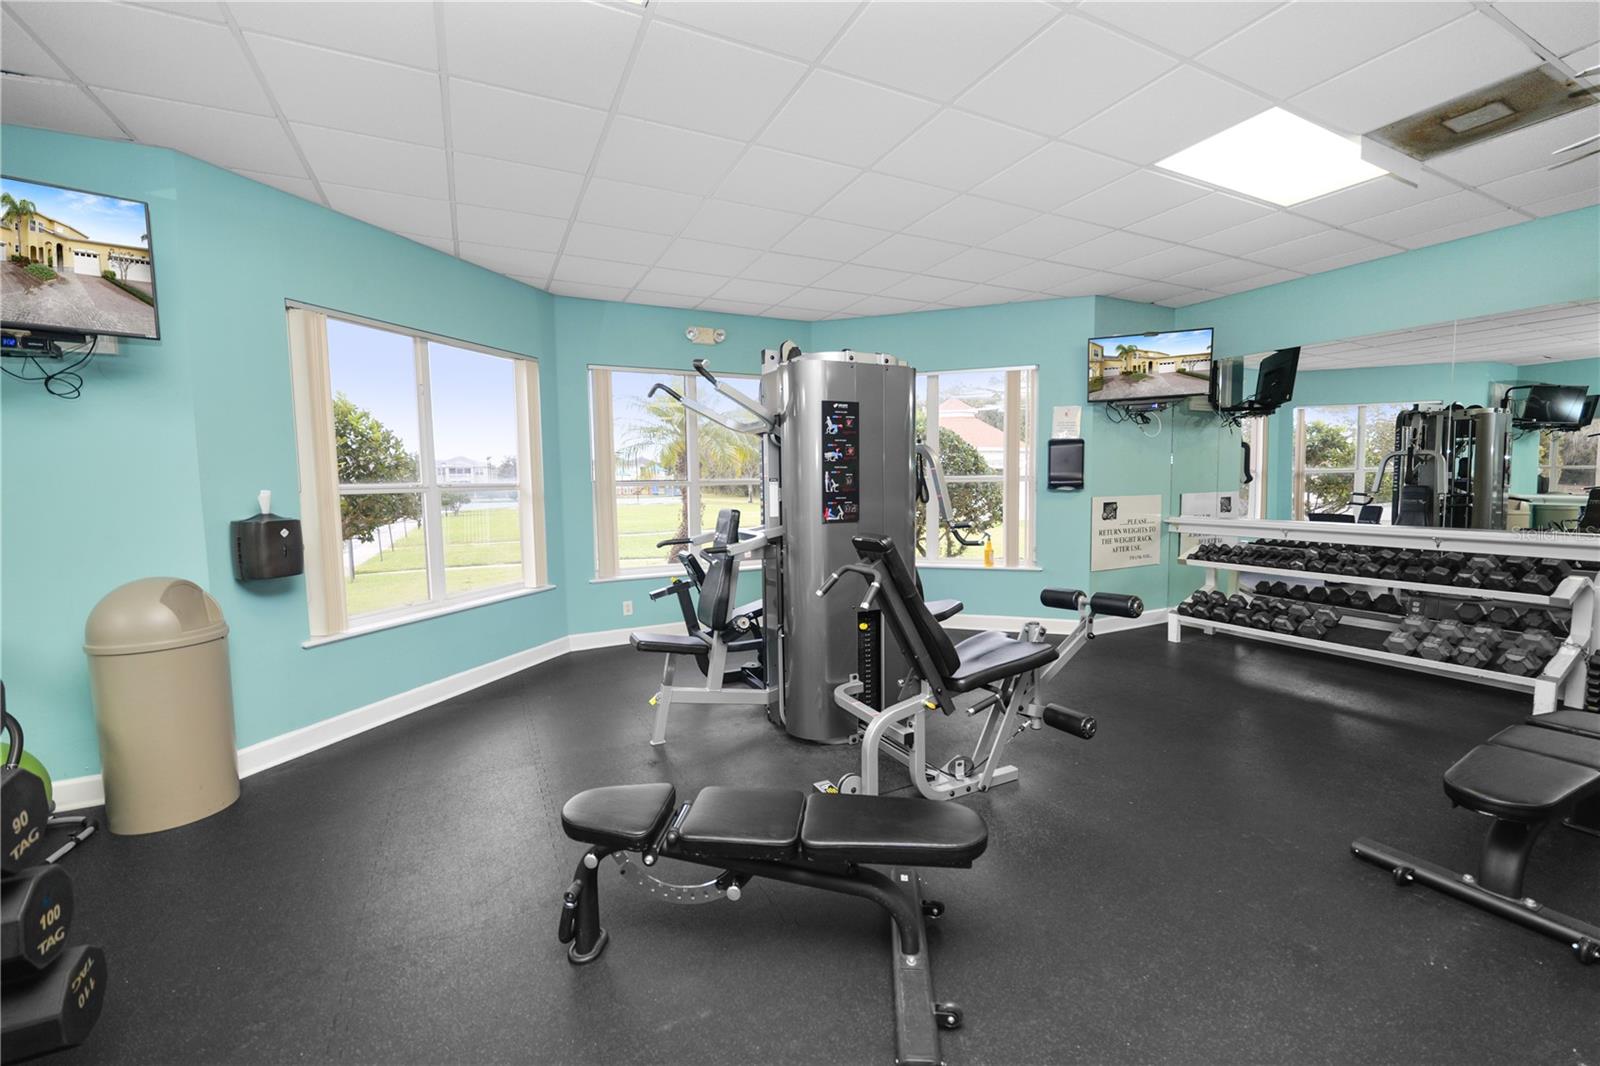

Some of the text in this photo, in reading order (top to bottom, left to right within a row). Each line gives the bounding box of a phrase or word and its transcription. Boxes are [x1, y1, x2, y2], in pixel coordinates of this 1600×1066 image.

[1098, 525, 1157, 536] RETURN WEIGHTS TO
[1114, 535, 1136, 543] WEIGHT
[1137, 534, 1153, 542] RACK
[1112, 545, 1130, 553] AFTER
[12, 809, 29, 835] 90
[39, 903, 61, 931] 100
[36, 925, 65, 956] TAG
[77, 977, 97, 1009] 110
